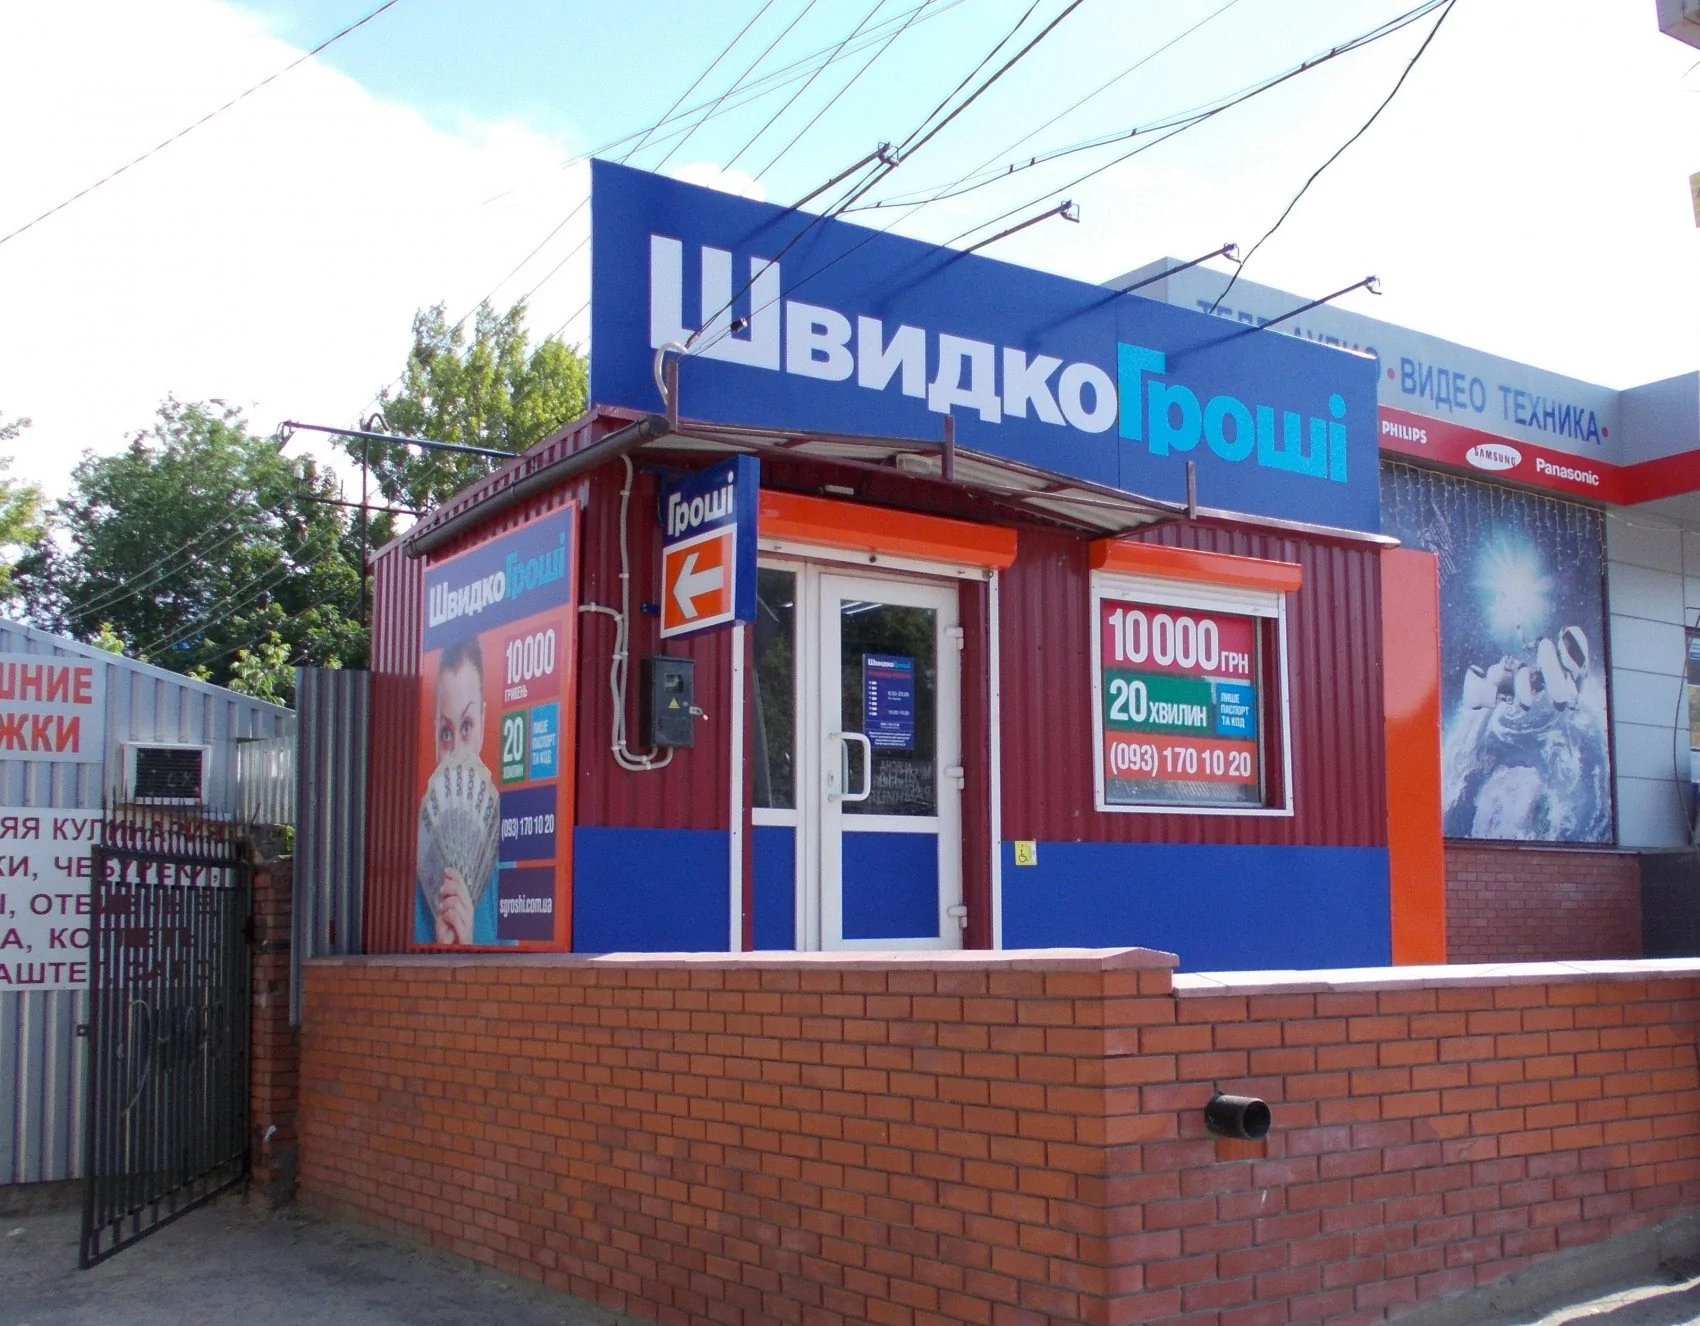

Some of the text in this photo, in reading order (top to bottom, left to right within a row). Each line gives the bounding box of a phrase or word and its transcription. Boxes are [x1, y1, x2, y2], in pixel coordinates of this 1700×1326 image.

[649, 234, 1348, 483] ШвидкоГроші
[1401, 357, 1600, 443] ВИДЕО ТЕХНИКА
[1381, 420, 1428, 444] PHILIPS
[1473, 445, 1517, 467] SAMSUNG
[1535, 457, 1600, 487] Panasonic
[667, 472, 733, 537] Гроші
[429, 533, 566, 628] ШвидкоГроші
[1220, 650, 1249, 674] ГРН
[1109, 679, 1207, 727] 20 ХВИЛИН
[1220, 704, 1250, 716] ПАСПОРТ
[1221, 715, 1231, 726] ТА
[503, 716, 524, 762] 20
[1110, 741, 1251, 777] (093) 170 10 20
[501, 813, 555, 842] (093) 170 10 20
[499, 894, 553, 918] sgroshi.com.ua
